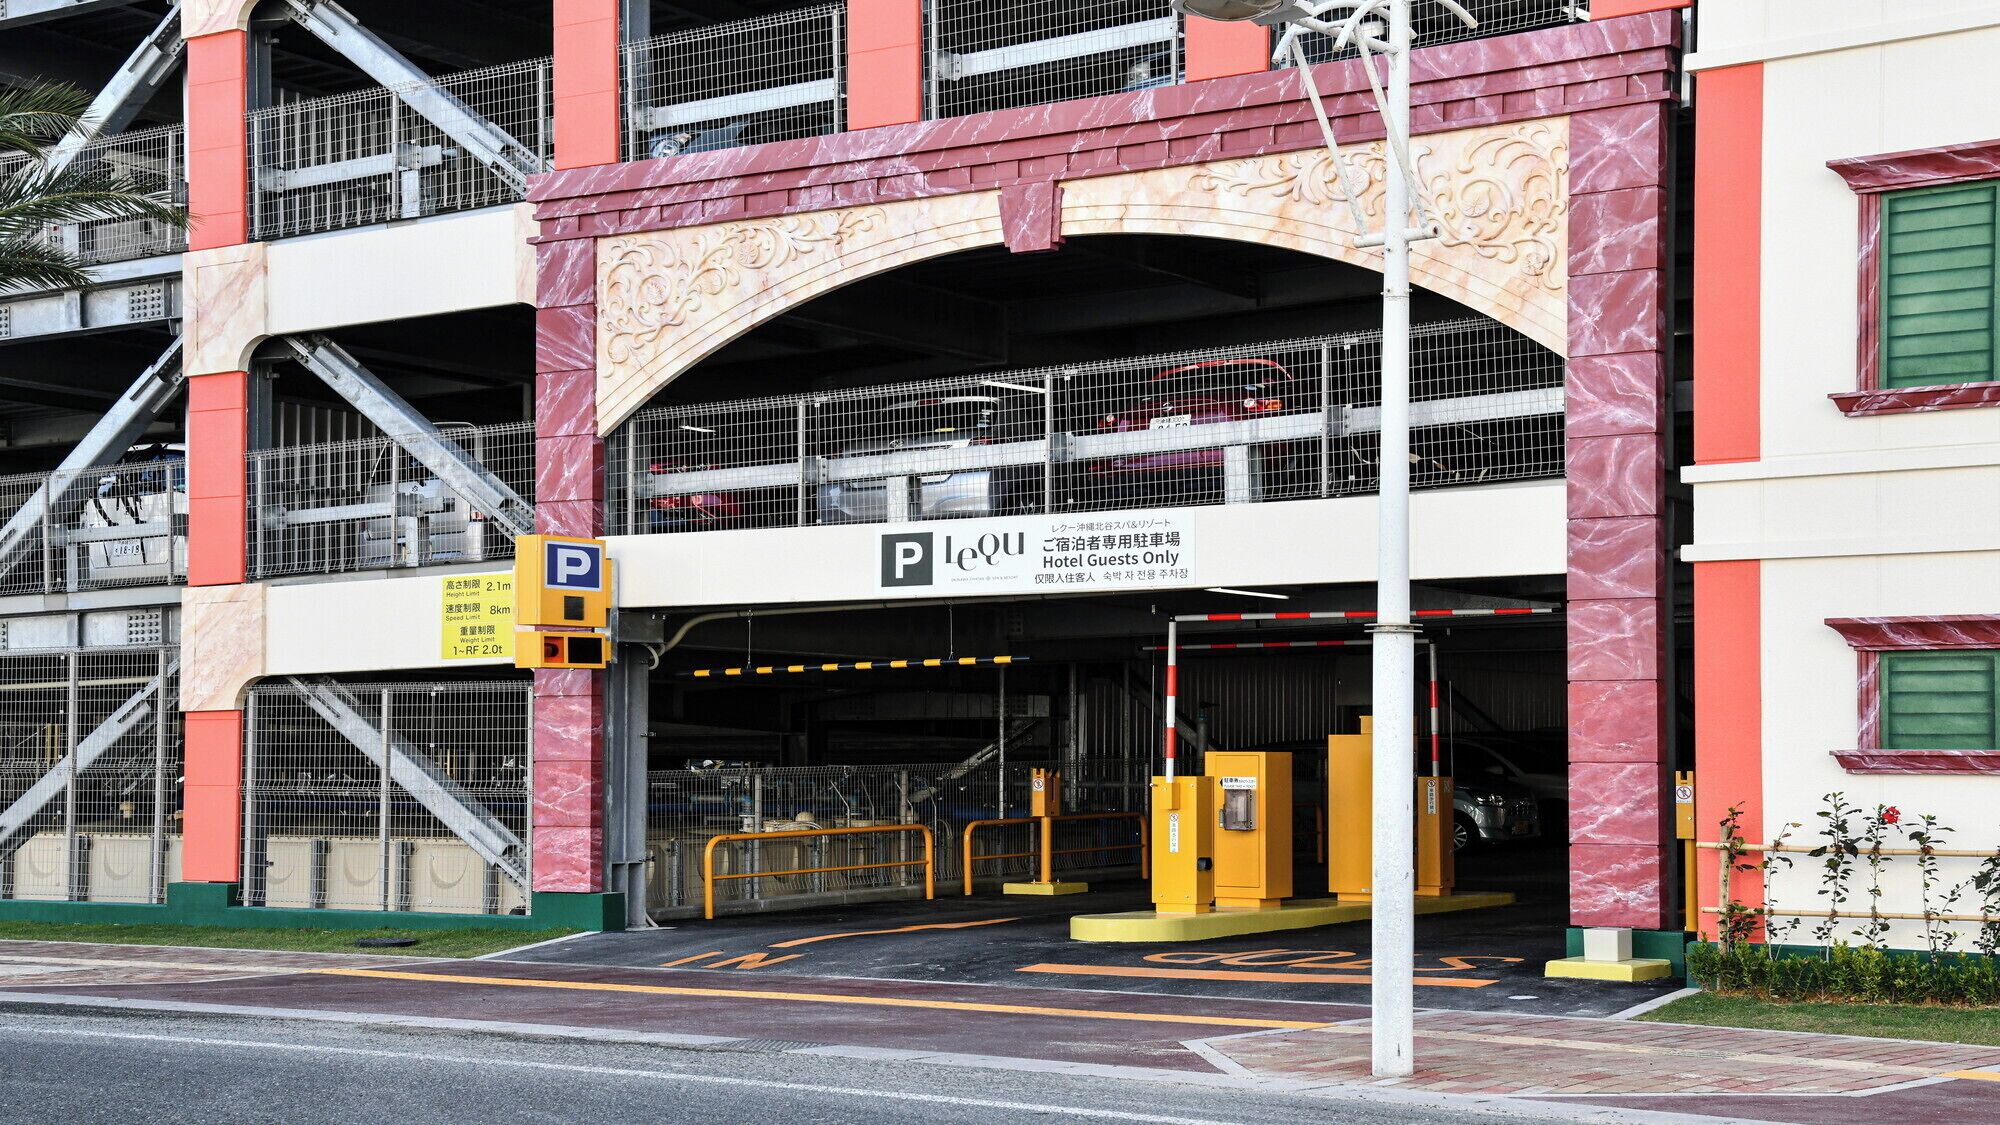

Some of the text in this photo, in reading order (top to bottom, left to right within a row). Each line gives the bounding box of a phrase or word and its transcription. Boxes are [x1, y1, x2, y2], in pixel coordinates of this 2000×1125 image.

[1043, 531, 1181, 552] ご宿泊者専用駐車場
[557, 548, 592, 584] P
[895, 541, 924, 579] P
[1043, 549, 1179, 569] Hotel Guests Only
[1034, 571, 1096, 585] 仅限入住客人
[1159, 567, 1189, 580] 주차장
[446, 578, 511, 592] 高さ制限 2.1m
[445, 602, 511, 615] 速度制限 8km
[460, 624, 496, 636] 重量制限
[460, 637, 480, 645] Weight
[482, 644, 503, 655] 2.0t
